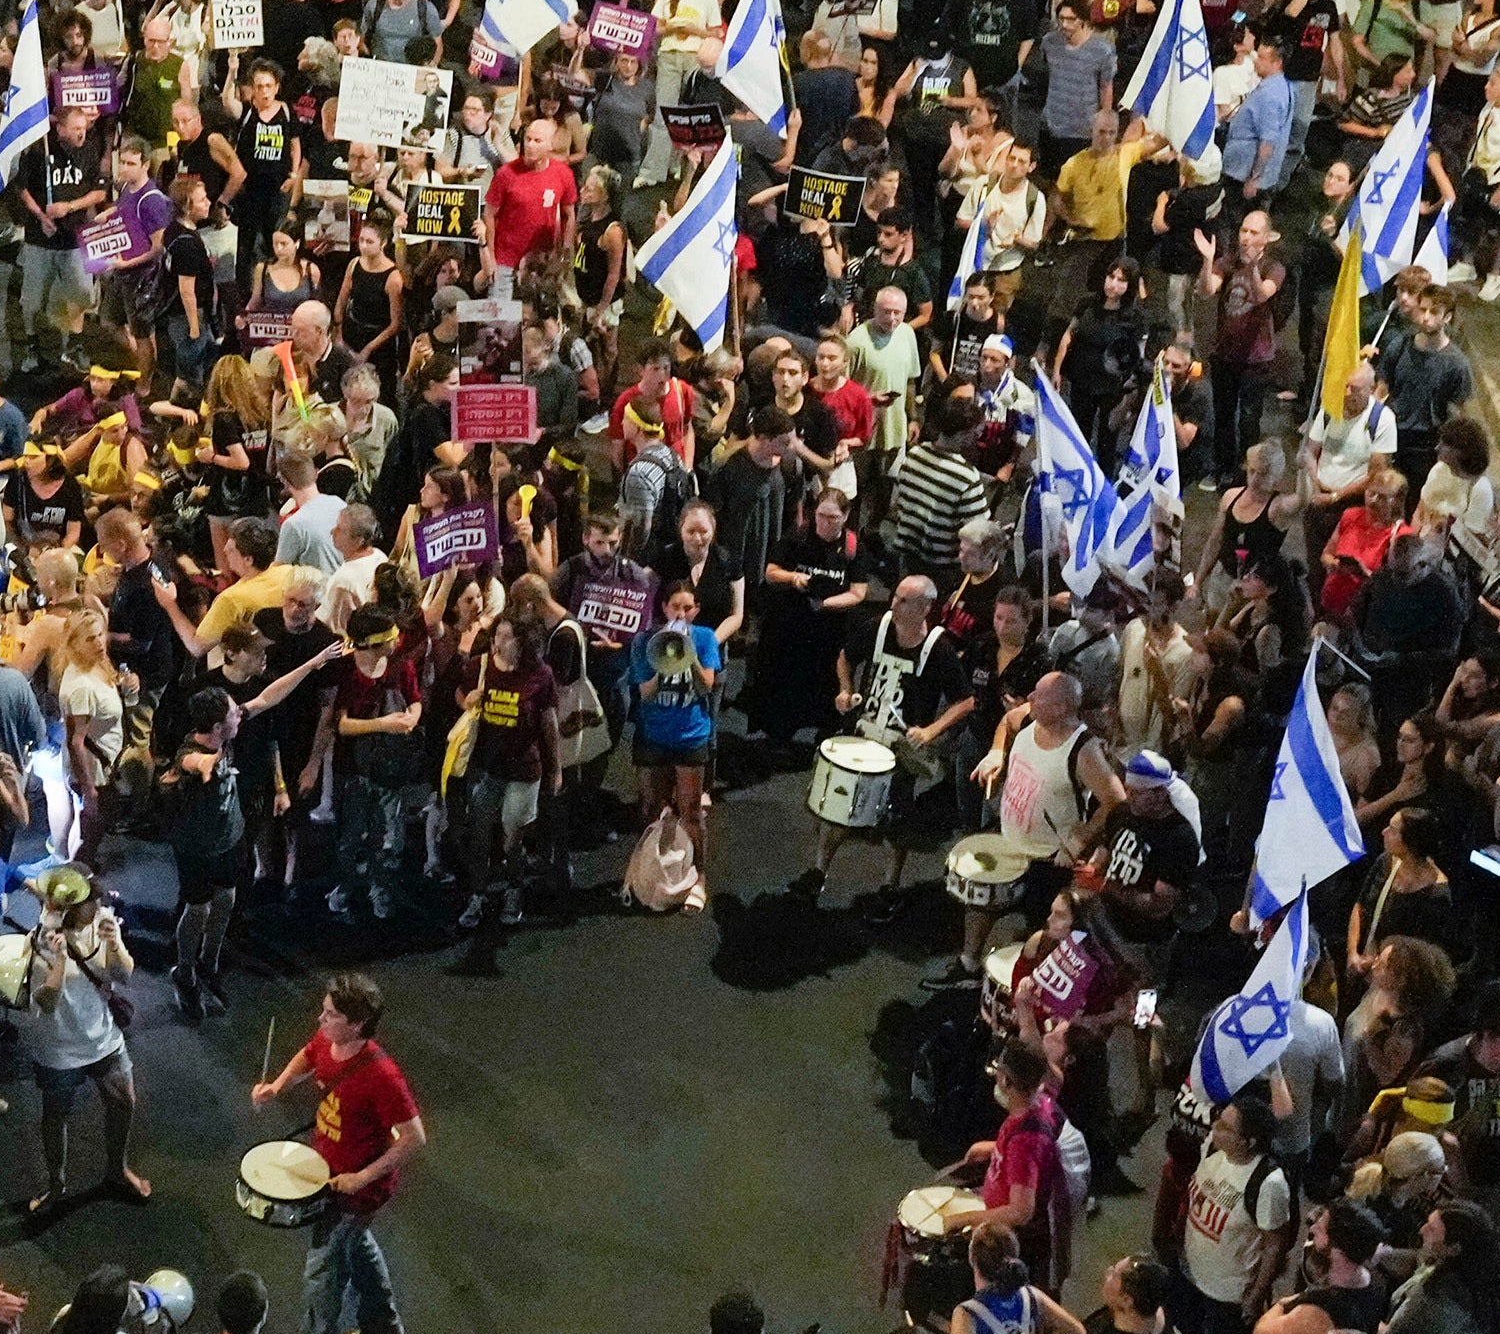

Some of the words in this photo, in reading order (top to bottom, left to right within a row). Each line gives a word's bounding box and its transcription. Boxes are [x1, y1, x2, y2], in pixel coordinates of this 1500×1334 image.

[220, 3, 255, 17] סבלו
[216, 17, 235, 28] גם
[593, 23, 641, 46] עכשיו
[65, 90, 109, 104] עכשיו
[51, 170, 84, 187] GAP
[802, 173, 850, 194] HOSTAGE
[418, 188, 465, 206] HOSTAGE
[800, 188, 827, 205] DEAL
[417, 204, 444, 220] DEAL
[799, 200, 825, 219] NOW
[416, 218, 442, 234] NOW
[89, 235, 130, 257] עכשיו
[254, 325, 293, 337] כשיו
[428, 530, 485, 561] עכשיו
[580, 600, 639, 634] עכשיו
